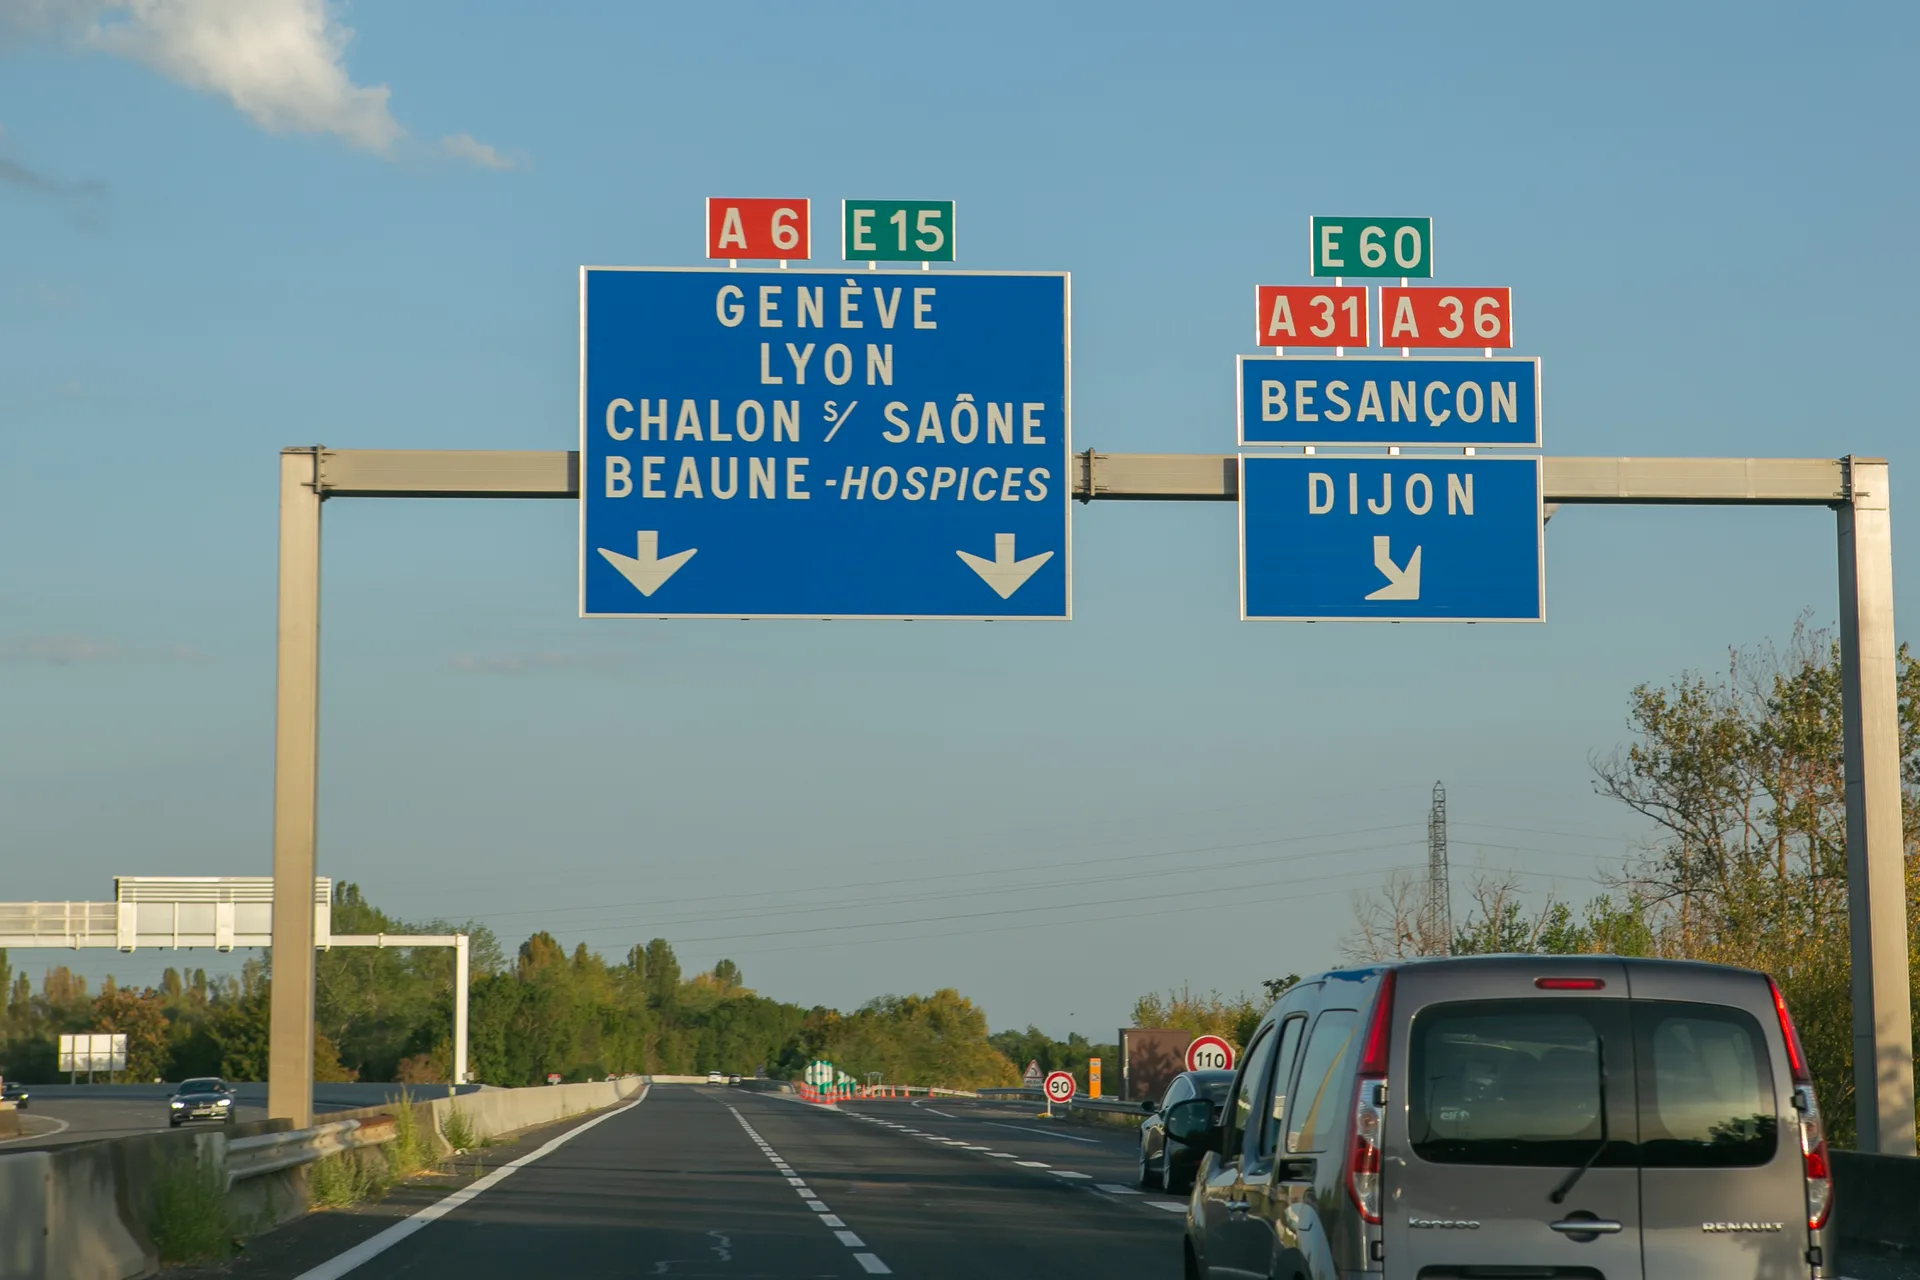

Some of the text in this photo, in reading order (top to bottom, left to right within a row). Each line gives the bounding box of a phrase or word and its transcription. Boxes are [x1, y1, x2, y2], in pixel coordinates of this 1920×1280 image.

[718, 207, 799, 250] A 6
[853, 209, 945, 252] E 15
[1321, 225, 1422, 269] E 60
[716, 278, 937, 330] GENÈVE
[1268, 295, 1359, 338] A 31
[1391, 296, 1501, 339] A 36
[760, 342, 894, 386] LYON
[605, 397, 801, 442] CHALON
[882, 394, 1046, 445] SAÔNE
[1261, 379, 1517, 427] BESANÇON
[605, 455, 811, 500] BEAUNE
[1308, 472, 1474, 515] DIJON
[1196, 1051, 1225, 1069] 110
[1051, 1081, 1070, 1094] 90
[1702, 1222, 1785, 1233] RENAULT
